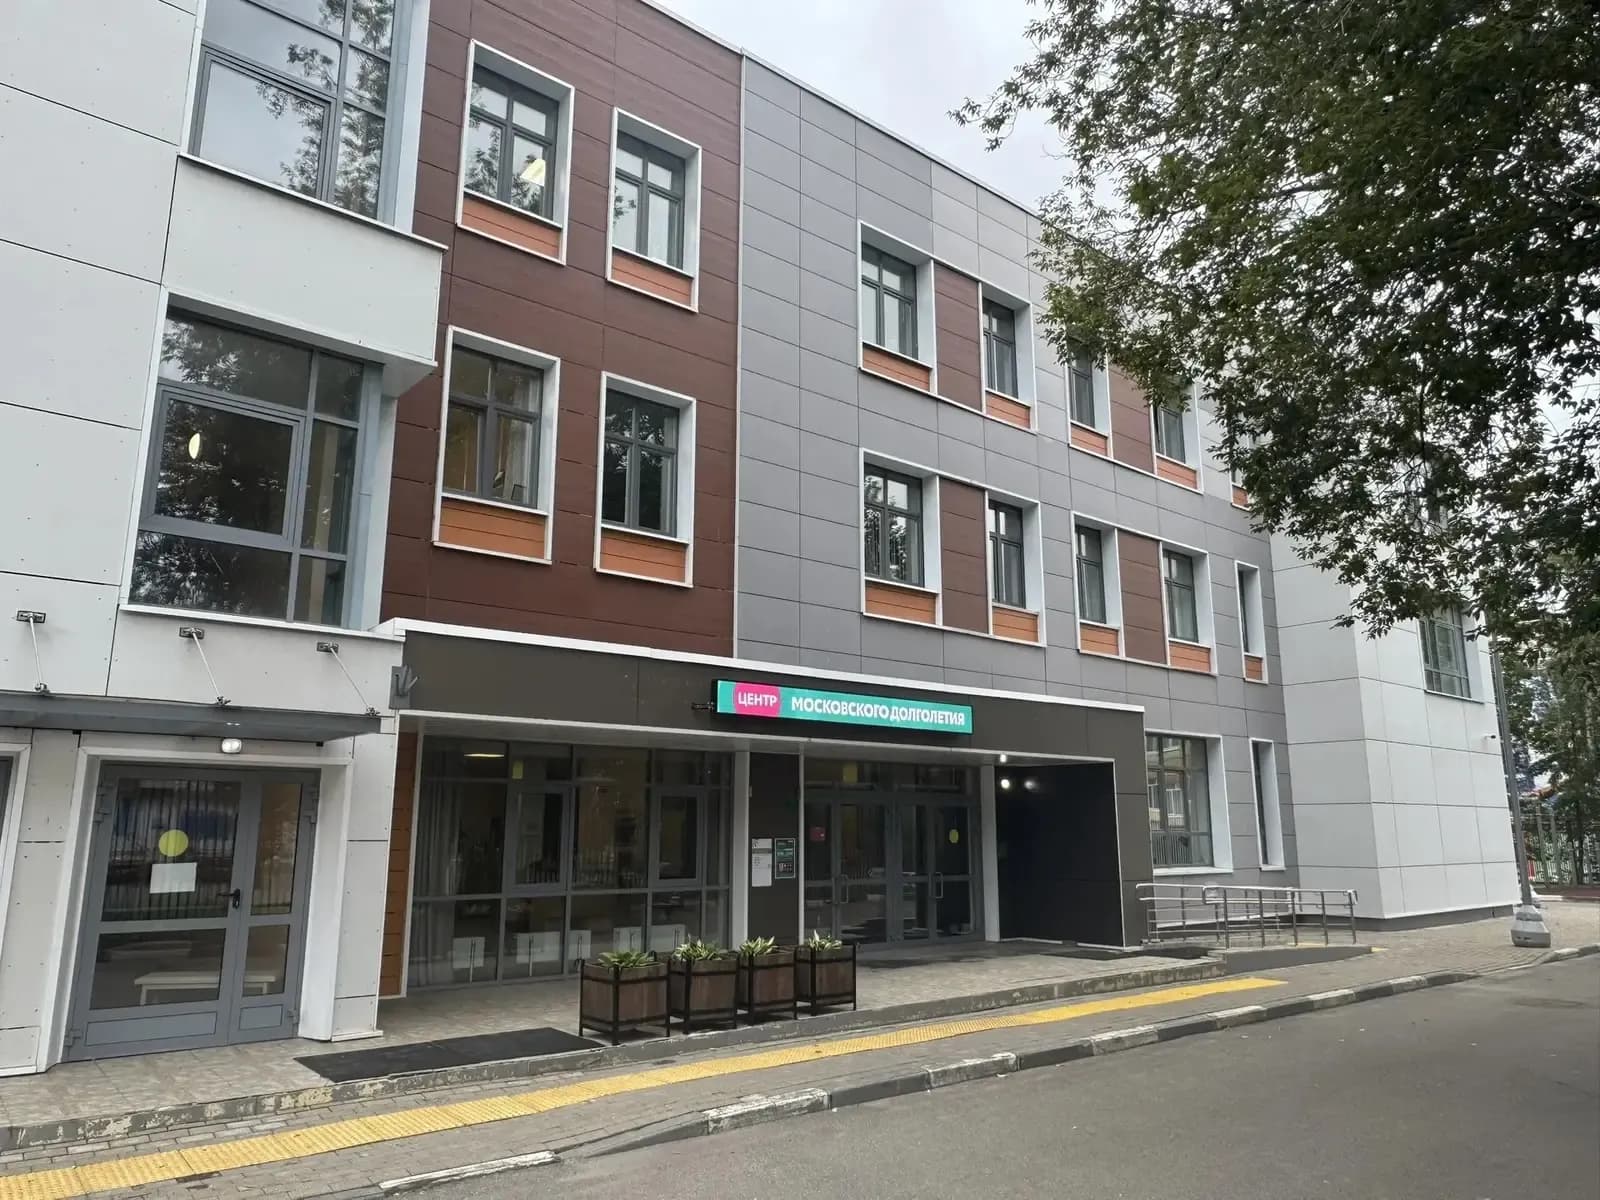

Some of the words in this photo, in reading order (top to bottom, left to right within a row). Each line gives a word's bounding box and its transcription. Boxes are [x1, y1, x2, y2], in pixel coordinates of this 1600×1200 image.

[737, 691, 778, 707] ЦЕНТР
[791, 696, 889, 720] МОСКОВСКОГО
[889, 708, 965, 726] ДОЛГОЛЕТИЯ
